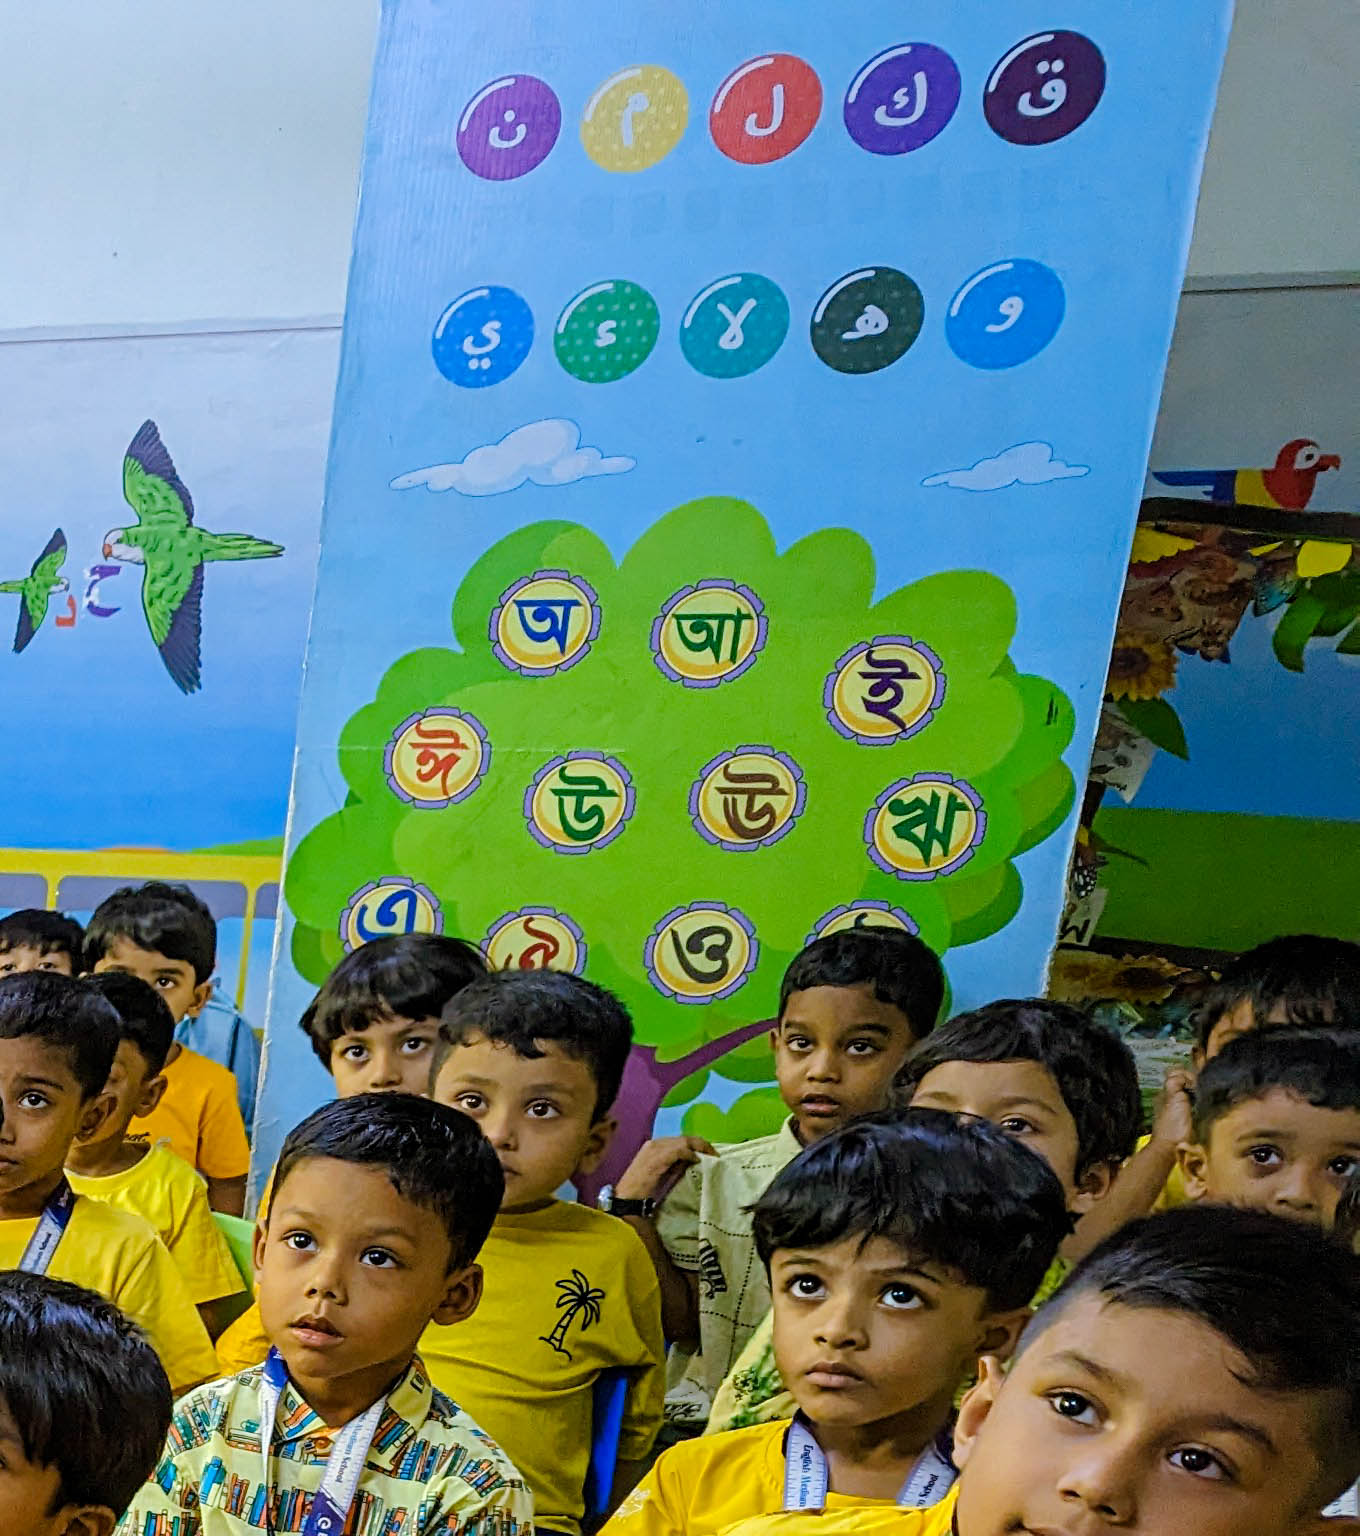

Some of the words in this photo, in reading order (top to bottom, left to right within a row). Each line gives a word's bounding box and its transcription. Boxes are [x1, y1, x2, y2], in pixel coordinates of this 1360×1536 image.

[744, 84, 785, 138] ل
[874, 70, 929, 127] ك
[1017, 59, 1068, 118] ق
[488, 110, 528, 150] ن
[621, 91, 651, 148] م
[984, 294, 1025, 334] و
[463, 318, 503, 370] ي
[512, 598, 581, 656] অ
[672, 606, 753, 666] আ
[860, 648, 920, 733] ই
[409, 719, 469, 797] ঈ
[549, 765, 621, 842] উ
[714, 763, 791, 840] ঊ
[887, 789, 971, 867] ঋ
[670, 925, 732, 984] ও
[335, 1455, 353, 1484] School
[800, 1444, 814, 1473] English
